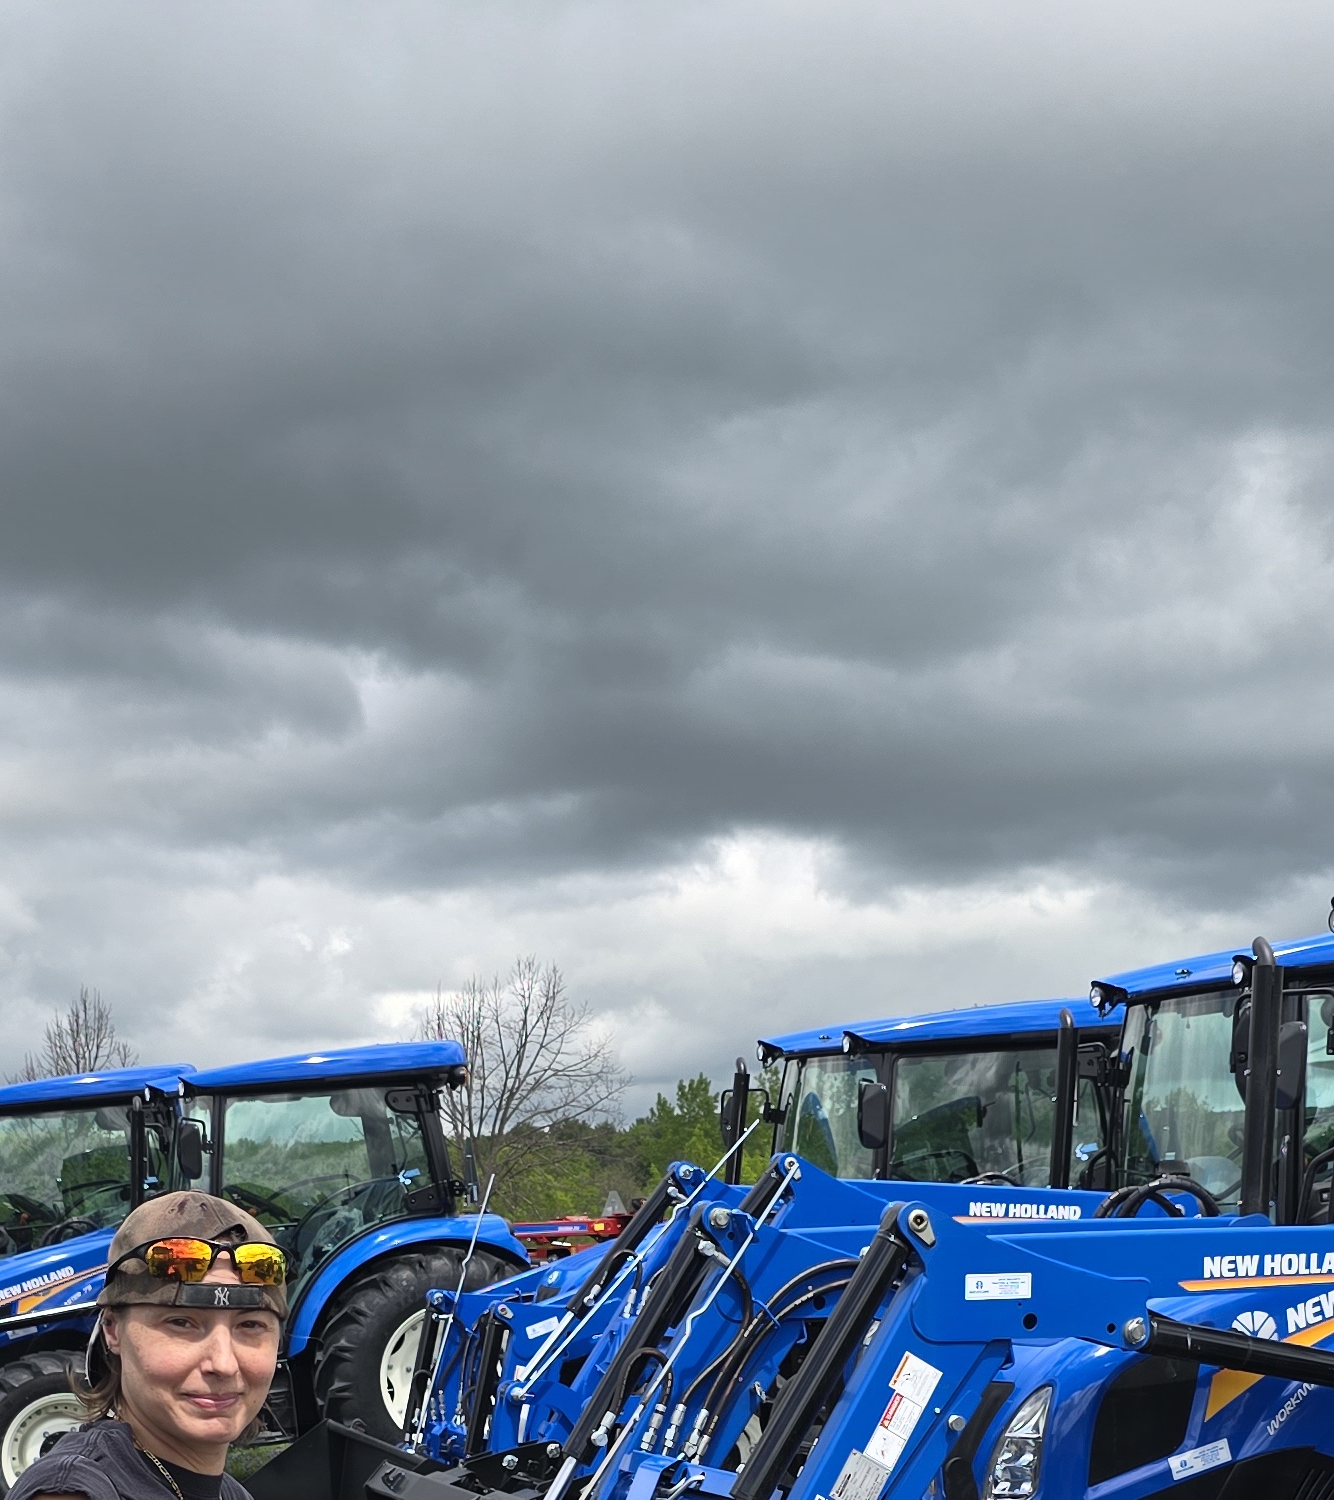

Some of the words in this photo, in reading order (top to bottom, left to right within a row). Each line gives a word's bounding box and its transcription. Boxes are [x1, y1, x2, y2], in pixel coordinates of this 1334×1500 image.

[969, 1201, 1007, 1218] NEW
[1008, 1203, 1082, 1221] HOLLAND
[1202, 1254, 1260, 1279] NEW
[21, 1265, 75, 1292] HOLLAND
[213, 1285, 230, 1306] NY
